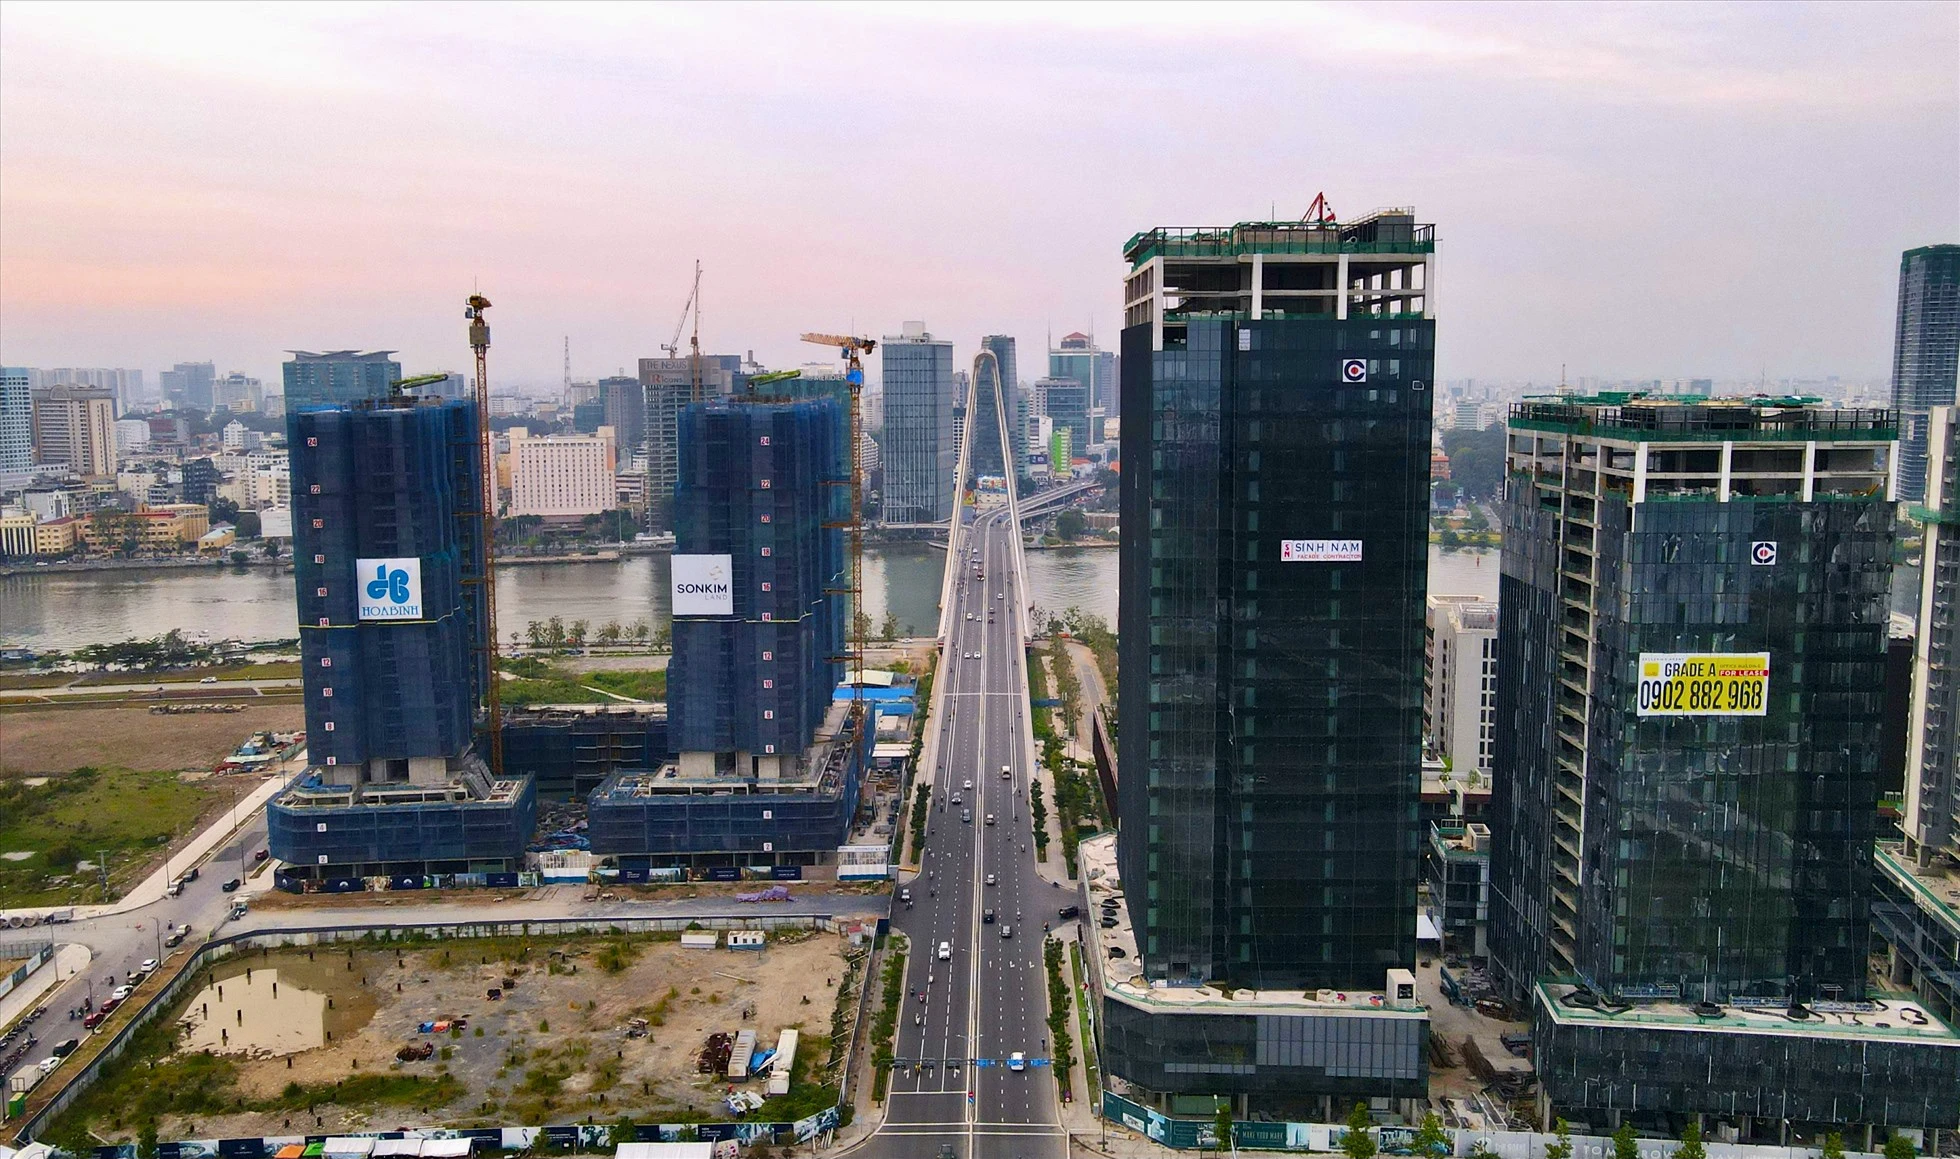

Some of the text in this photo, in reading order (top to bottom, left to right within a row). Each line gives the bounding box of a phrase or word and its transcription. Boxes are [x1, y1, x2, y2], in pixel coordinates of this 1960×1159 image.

[661, 361, 687, 369] NEXUS
[1295, 543, 1359, 552] SINH NAM
[677, 583, 727, 594] SONKIM
[362, 605, 419, 616] HOABINH
[1665, 662, 1716, 677] GRADE A
[1640, 680, 1763, 710] 0902 882 968
